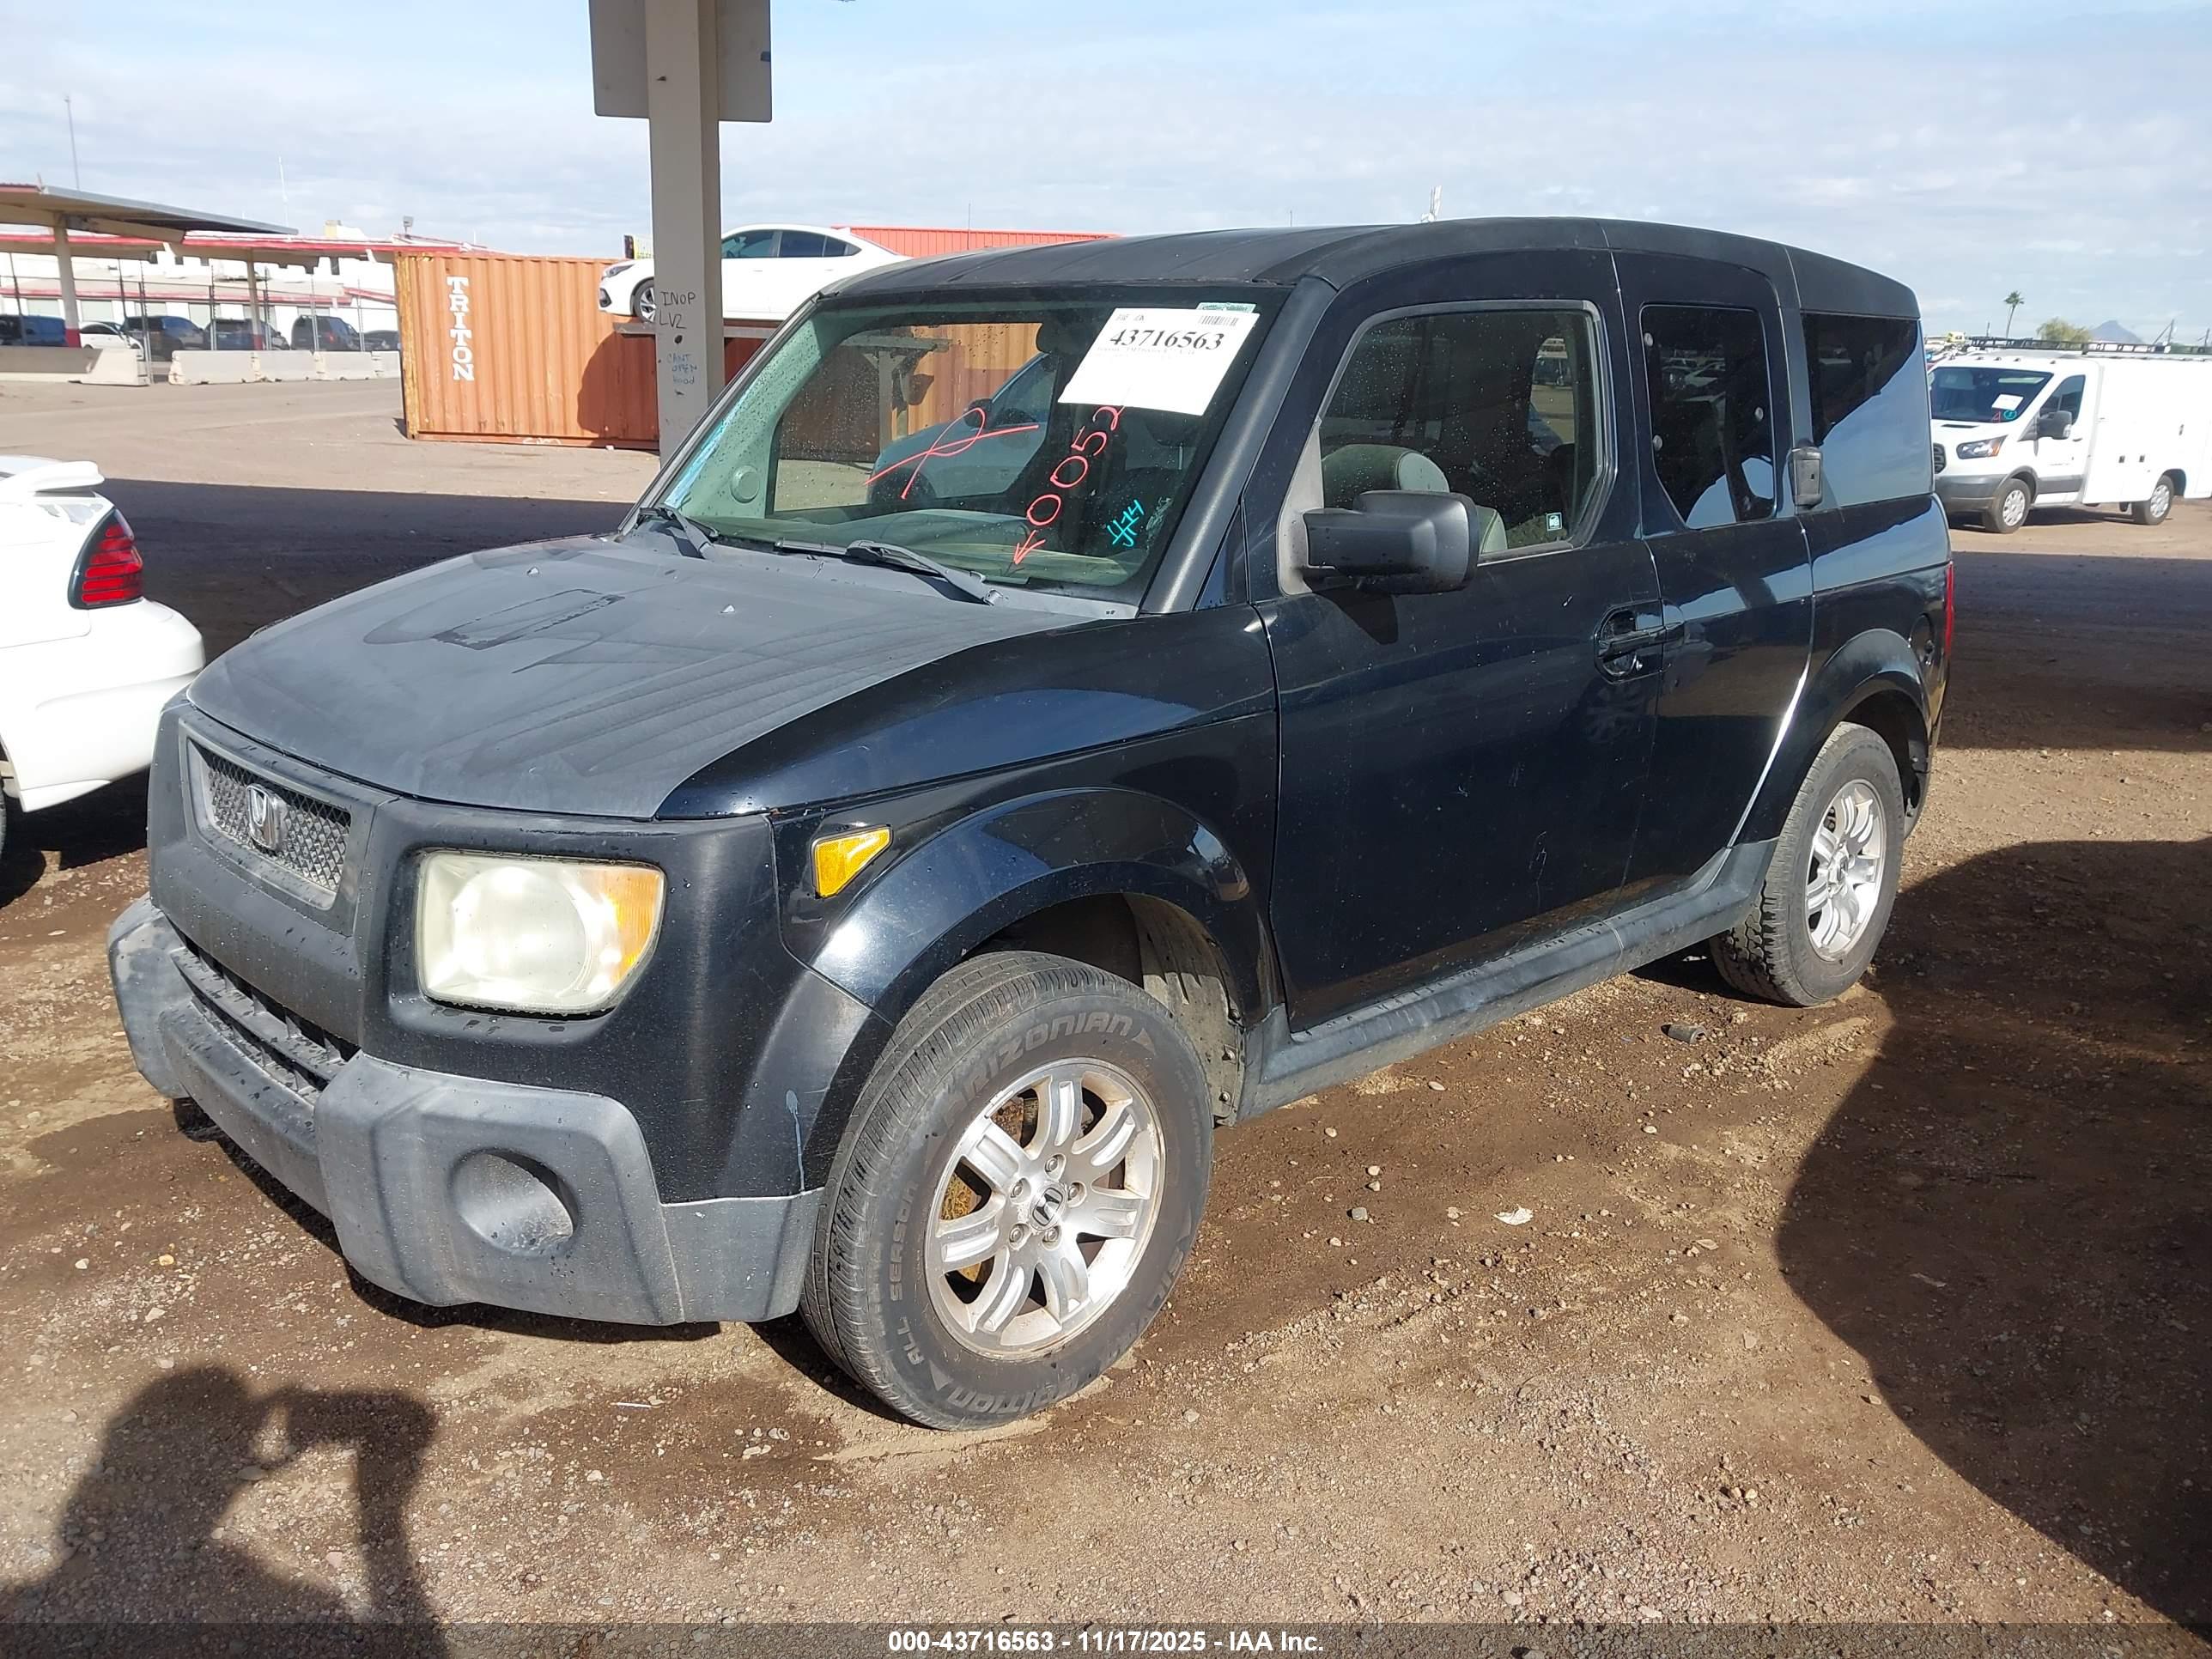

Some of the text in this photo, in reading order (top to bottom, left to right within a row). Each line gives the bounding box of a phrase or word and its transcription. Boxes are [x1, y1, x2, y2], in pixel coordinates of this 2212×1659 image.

[447, 276, 475, 381] TRITON
[659, 291, 696, 306] INOP
[1110, 329, 1225, 350] 43716563
[888, 1180, 918, 1303] SEASON
